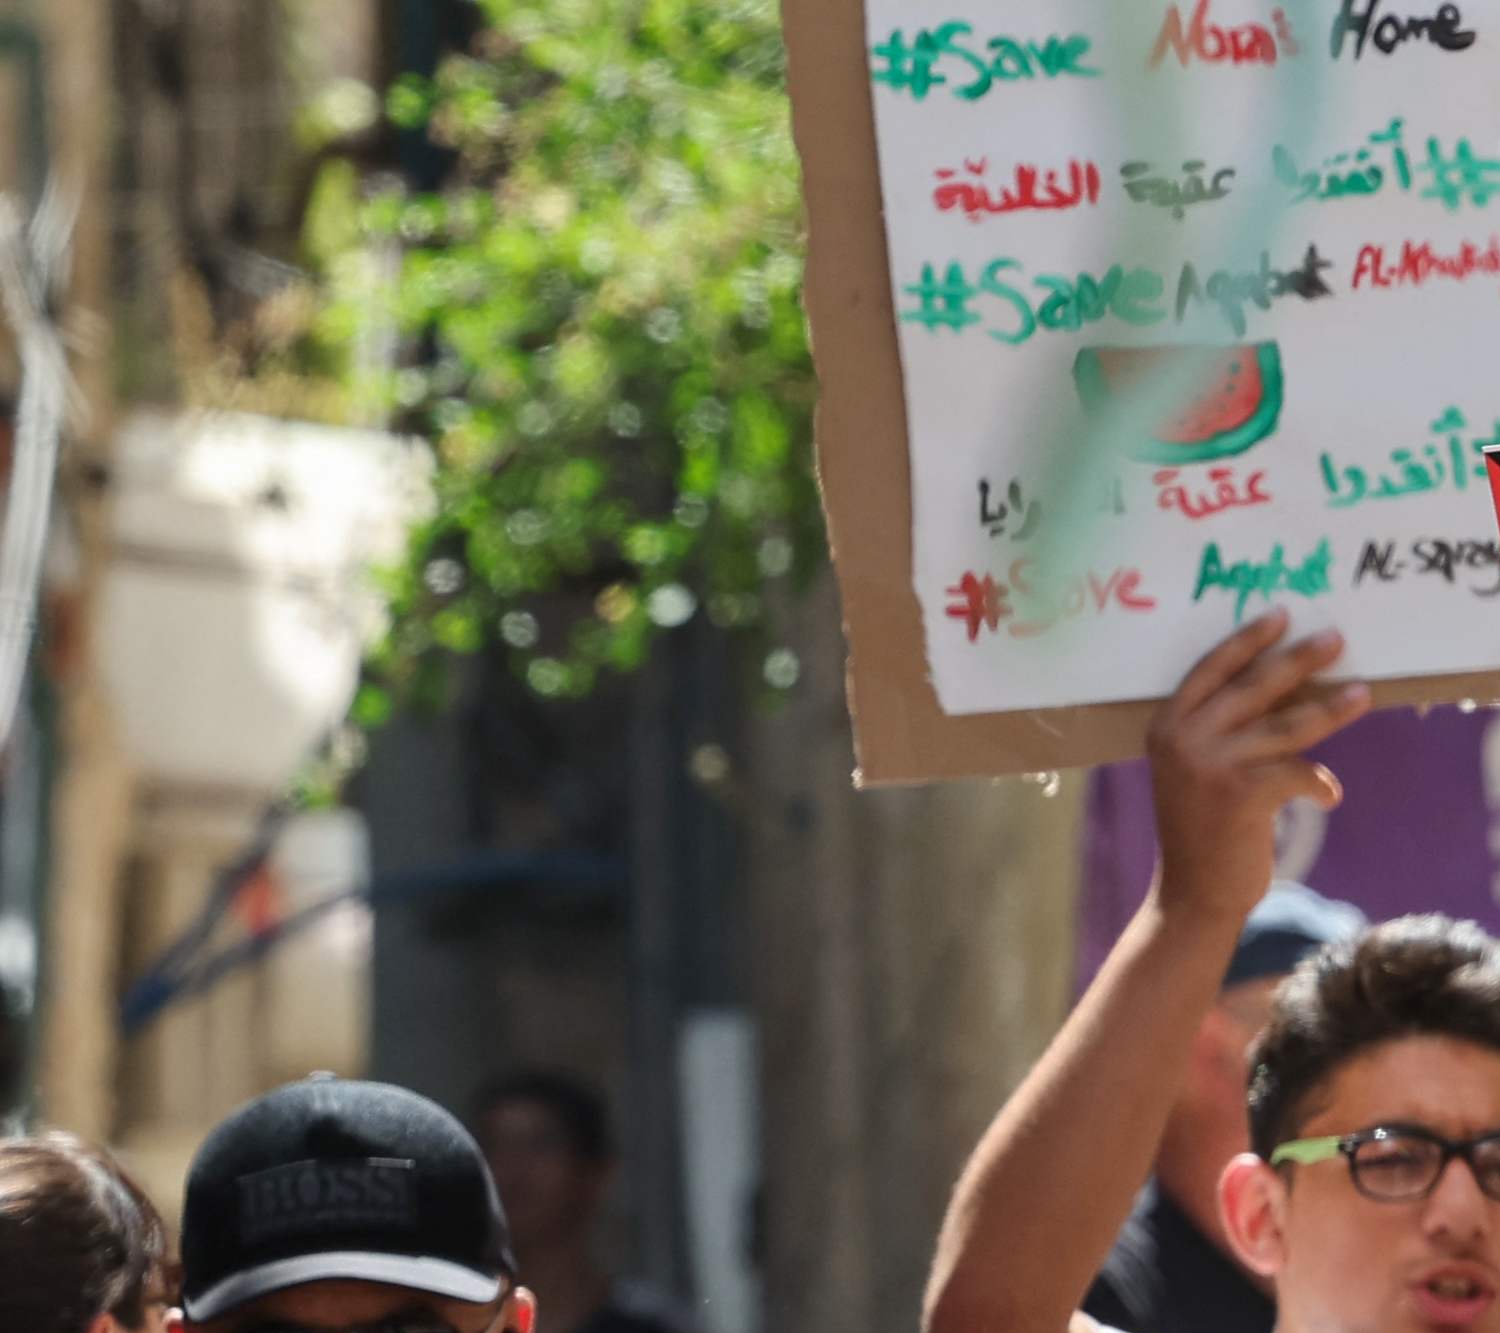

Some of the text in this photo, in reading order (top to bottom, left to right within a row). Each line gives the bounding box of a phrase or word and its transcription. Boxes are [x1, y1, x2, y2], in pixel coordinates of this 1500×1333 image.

[871, 20, 1102, 100] #Save
[1330, 0, 1476, 60] Home
[901, 257, 1168, 345] #Save
